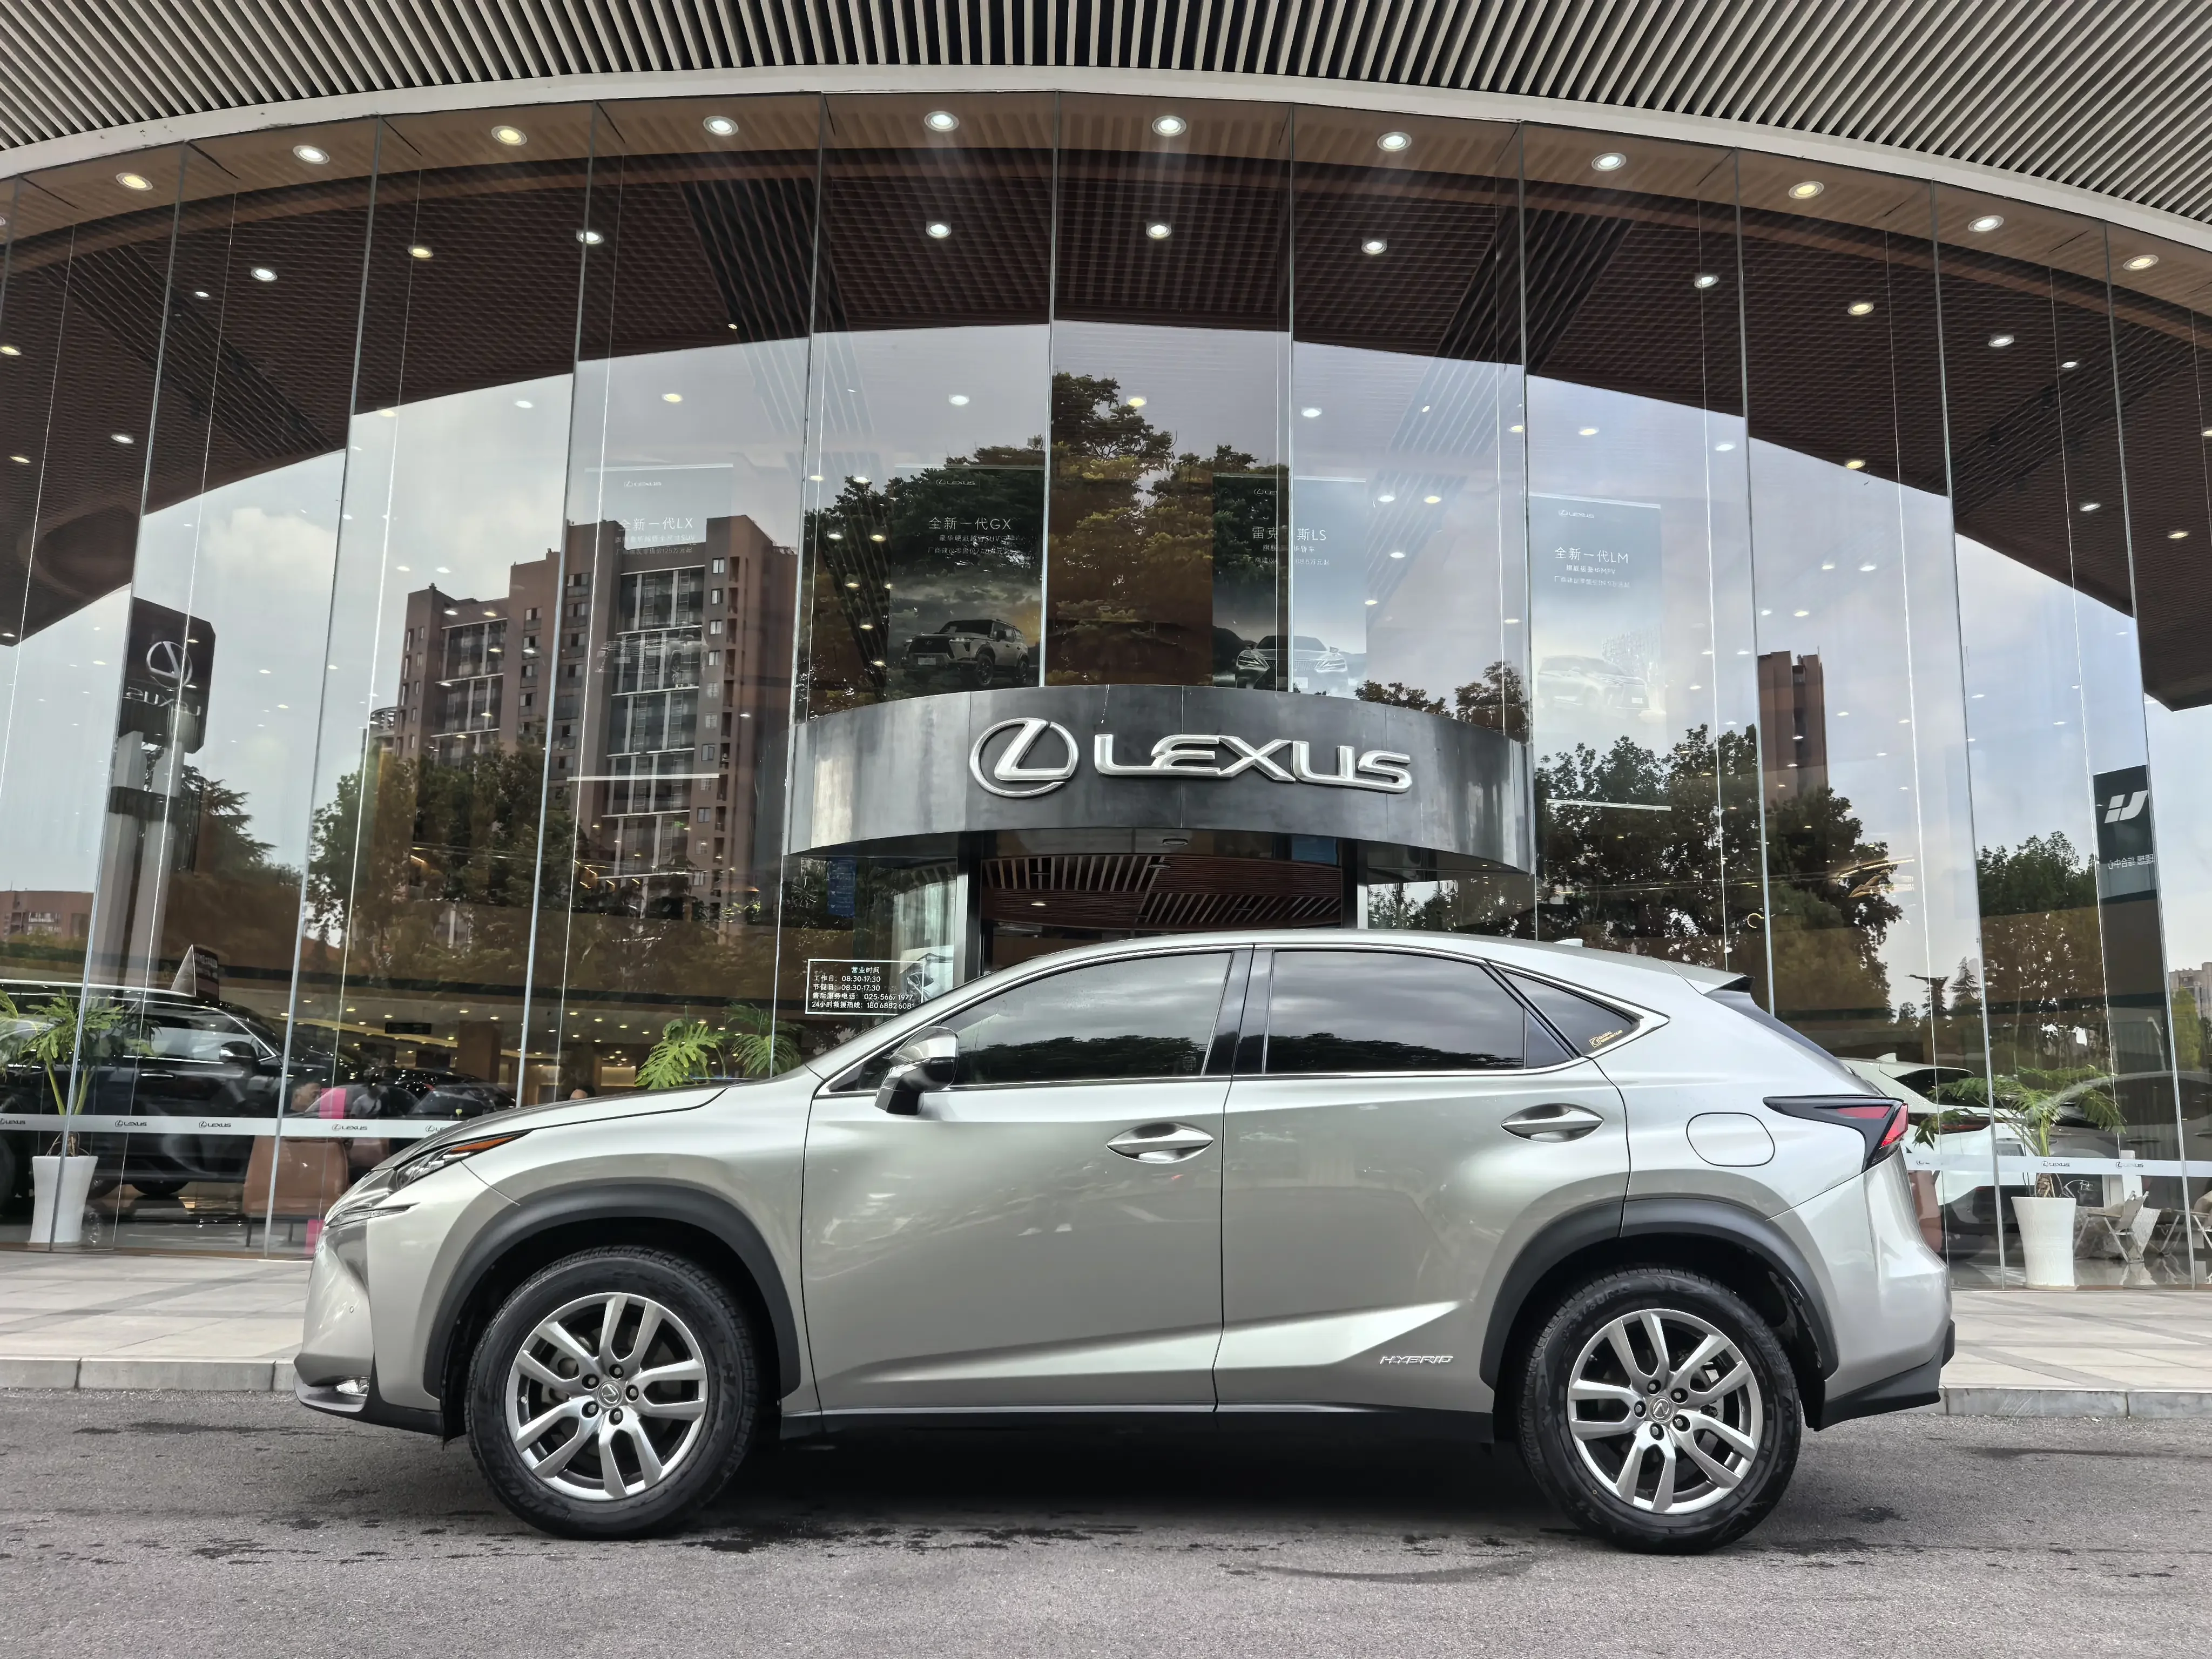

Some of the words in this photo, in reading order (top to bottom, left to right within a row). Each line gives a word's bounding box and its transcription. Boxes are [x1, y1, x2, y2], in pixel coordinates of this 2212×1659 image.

[618, 516, 693, 531] 全新一代LX
[928, 516, 1011, 530] 全新一代GX
[1252, 525, 1327, 541] 雷克斯LS
[1554, 547, 1629, 564] 全新一代LM
[1094, 733, 1412, 794] LEXUS
[851, 966, 880, 974] 营业时间
[813, 983, 837, 992] 节假日：
[1379, 1354, 1454, 1365] HYBRID
